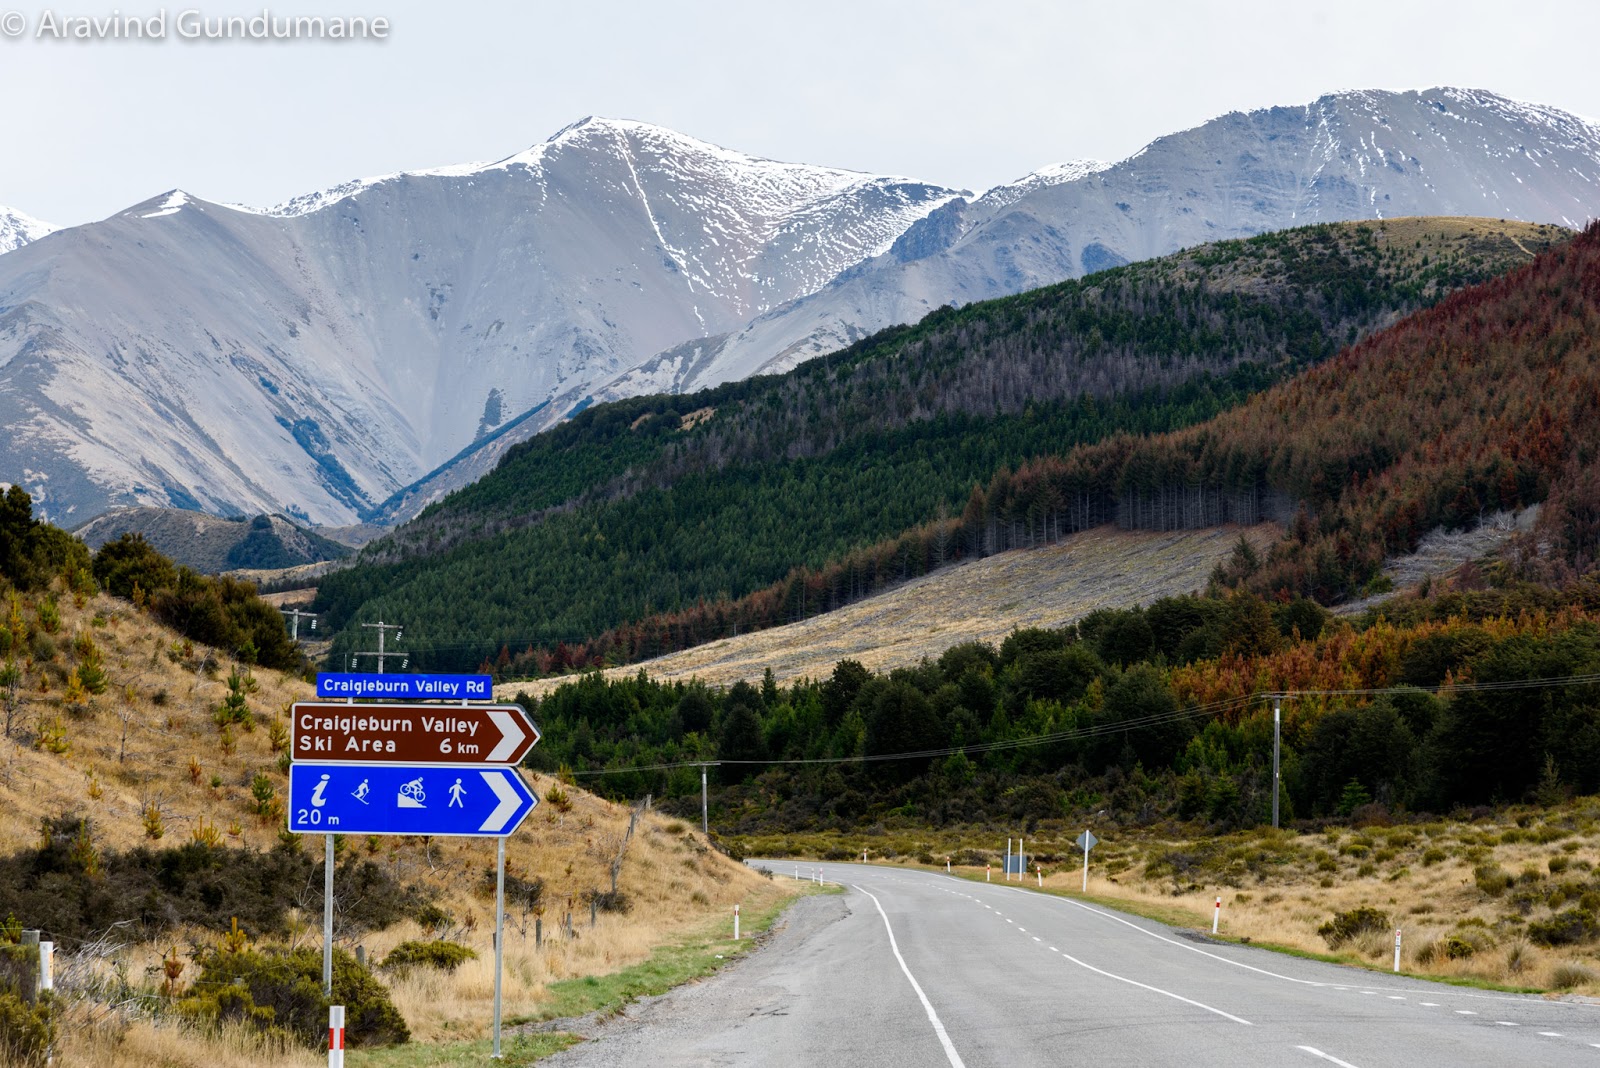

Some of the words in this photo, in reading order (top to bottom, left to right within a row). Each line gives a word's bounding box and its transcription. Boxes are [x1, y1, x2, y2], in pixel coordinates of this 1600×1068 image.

[324, 679, 409, 695] Craigieburn
[416, 680, 459, 695] Valley
[466, 681, 484, 693] Rd
[300, 714, 412, 735] Craigieburn
[421, 716, 479, 736] Valley
[299, 736, 332, 751] Ski
[345, 736, 396, 752] Area
[440, 738, 452, 753] 6
[458, 742, 479, 754] km
[297, 809, 321, 825] 20
[328, 816, 339, 825] m
